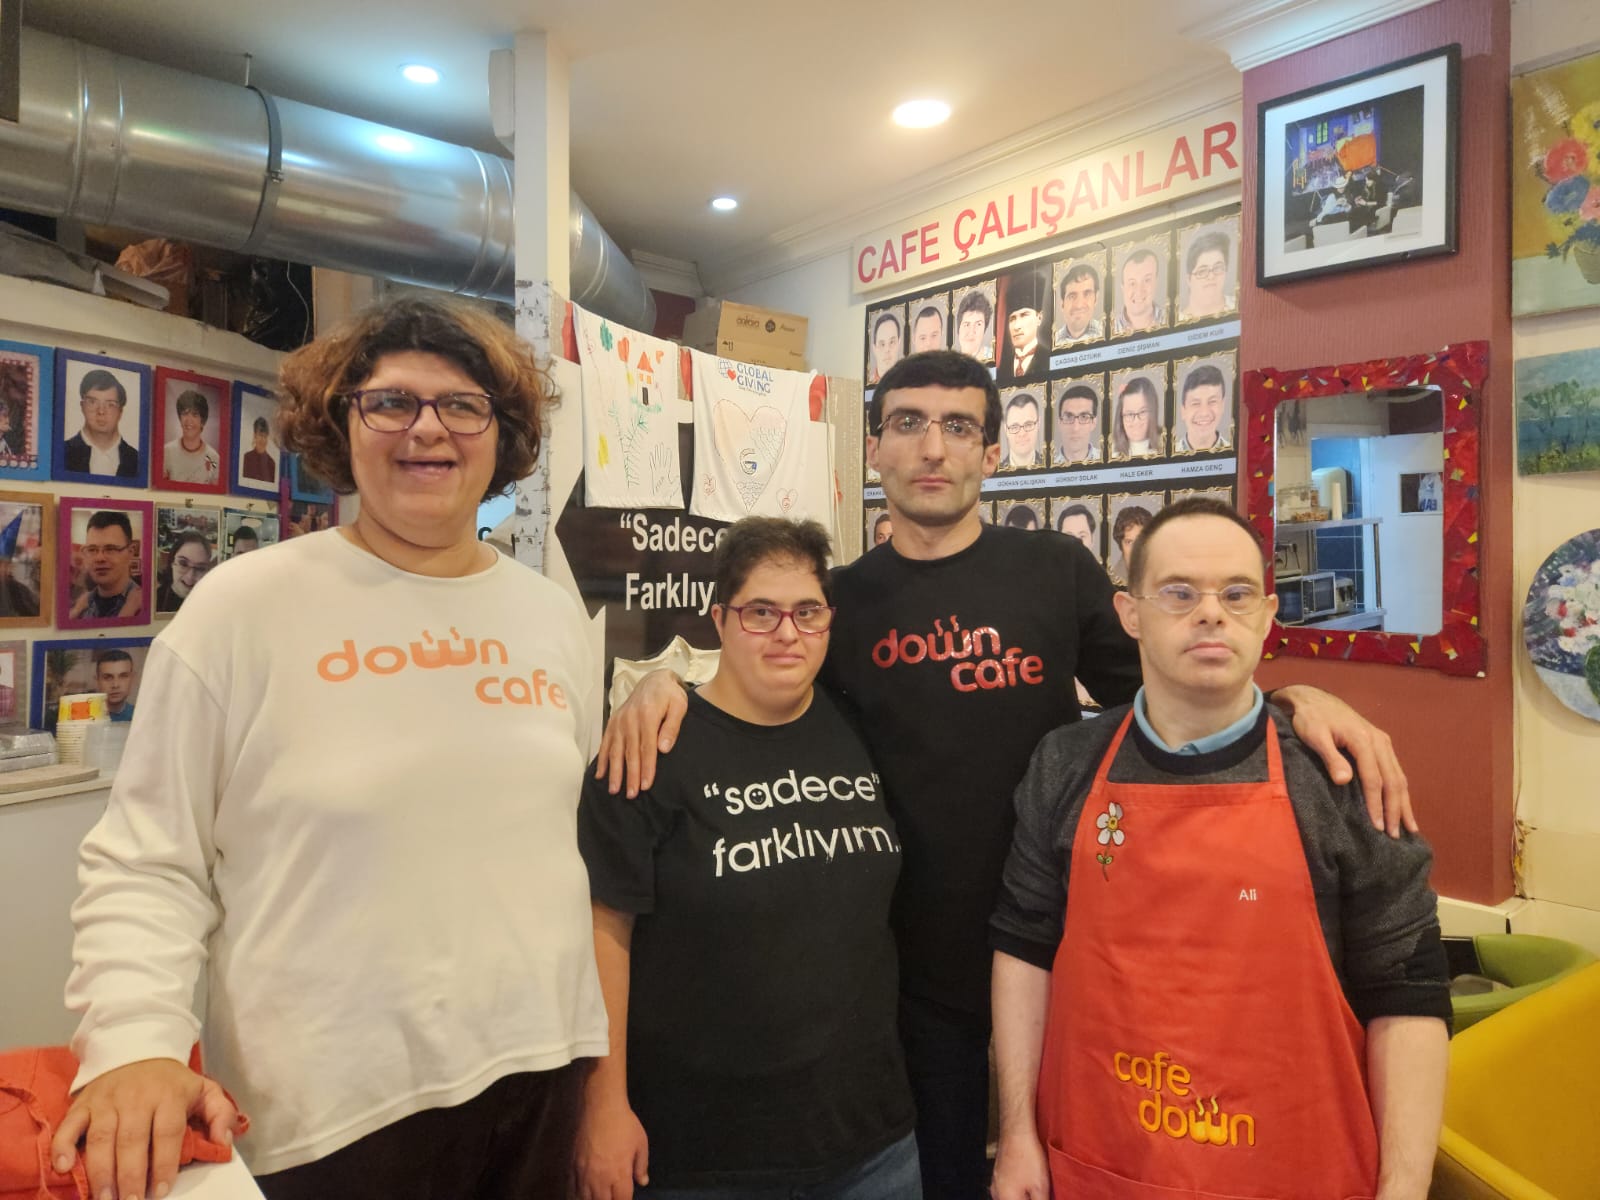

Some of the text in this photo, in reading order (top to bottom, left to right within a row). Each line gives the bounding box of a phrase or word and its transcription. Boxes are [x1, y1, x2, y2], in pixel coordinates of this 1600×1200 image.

[857, 121, 1239, 284] CAFE ÇALIŞANLAR
[736, 362, 774, 383] GLOBAL
[736, 375, 771, 394] GIVING
[1120, 469, 1153, 479] HALE EKER
[1181, 465, 1203, 474] HAMZA
[316, 627, 509, 683] down
[872, 615, 1001, 669] down
[475, 669, 568, 710] cafe
[951, 647, 1044, 693] cafe
[1238, 888, 1257, 901] Ali
[1114, 1052, 1191, 1096] cafe
[1138, 1092, 1255, 1146] down
